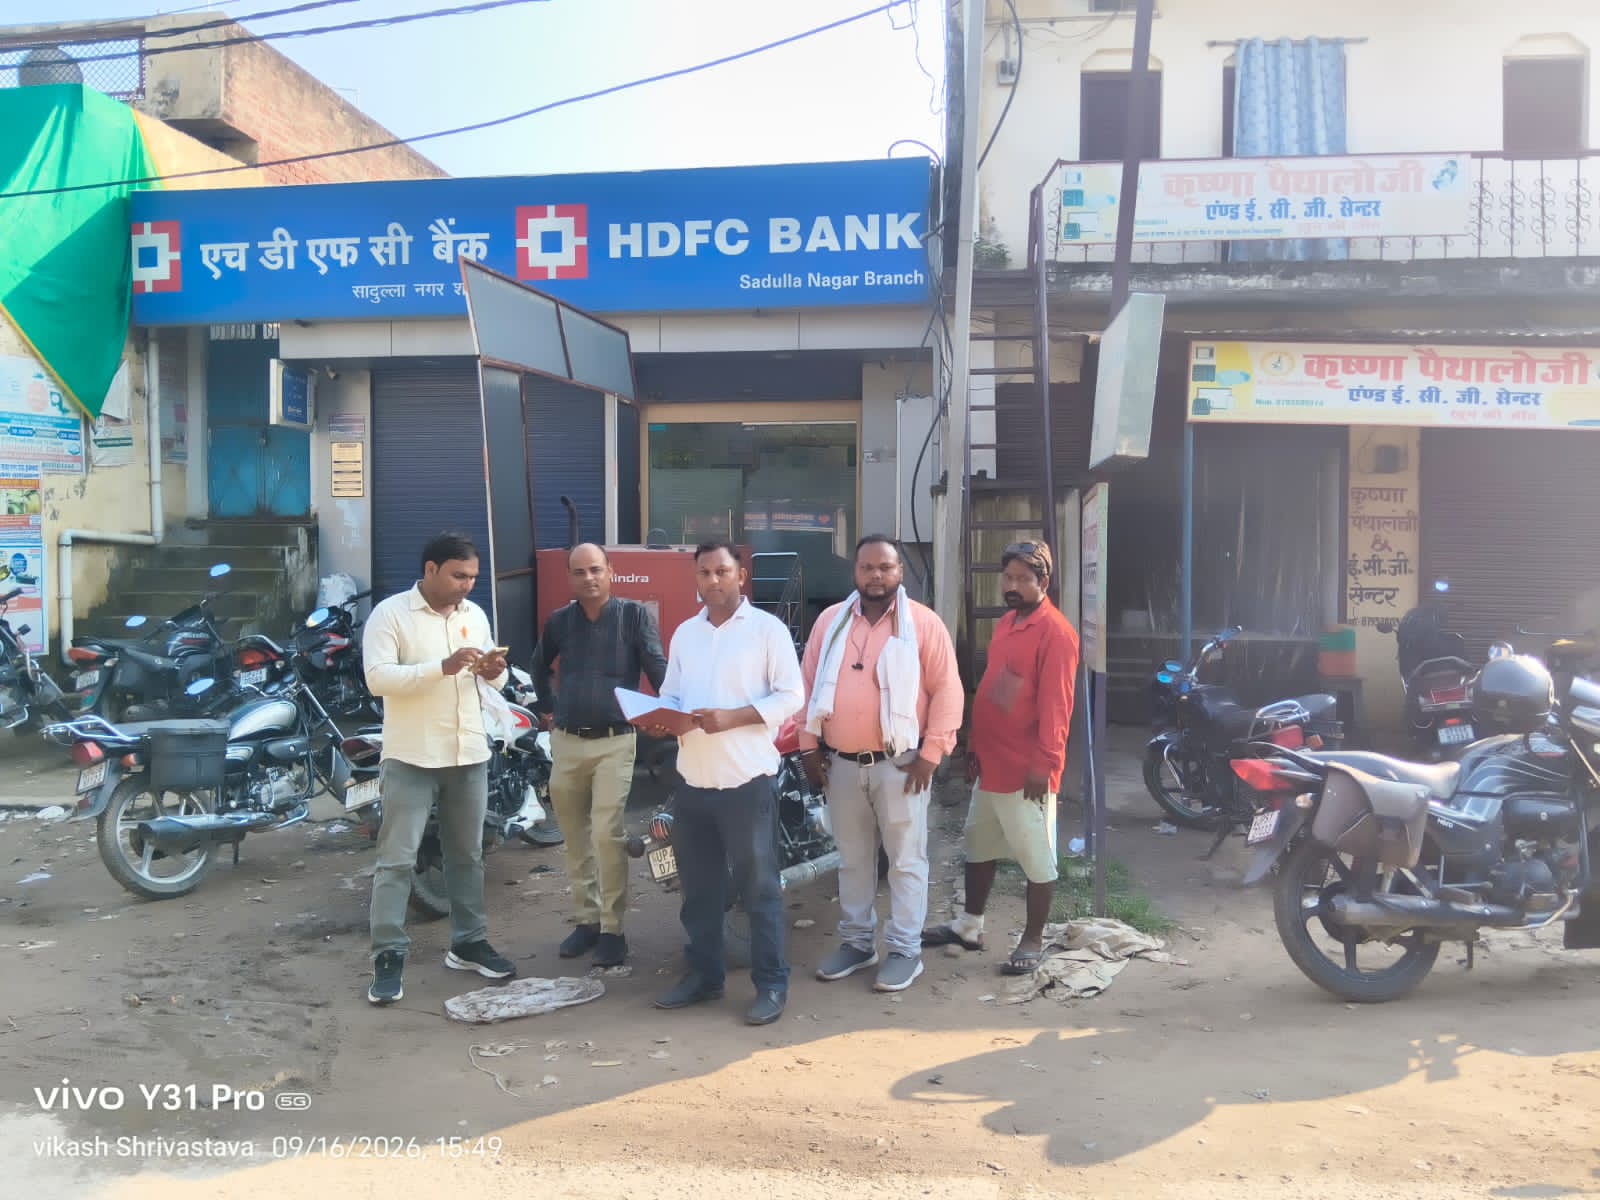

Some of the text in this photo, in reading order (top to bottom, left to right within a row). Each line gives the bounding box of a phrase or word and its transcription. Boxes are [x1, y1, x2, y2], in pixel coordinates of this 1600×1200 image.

[1161, 172, 1256, 207] कृष्णा
[1340, 196, 1381, 217] सेन्टर
[608, 212, 924, 258] HDFC BANK
[200, 242, 249, 280] एच
[257, 227, 298, 270] डी
[306, 237, 360, 275] एफ
[368, 222, 413, 266] सी
[739, 269, 924, 290] Sadulla Nagar Branch
[352, 283, 406, 304] सादुल्ला
[413, 283, 444, 297] नगर
[1302, 354, 1409, 389] कृष्णा
[1496, 387, 1542, 406] सेन्टर
[1370, 533, 1392, 552] &
[1348, 582, 1399, 607] सेन्टर
